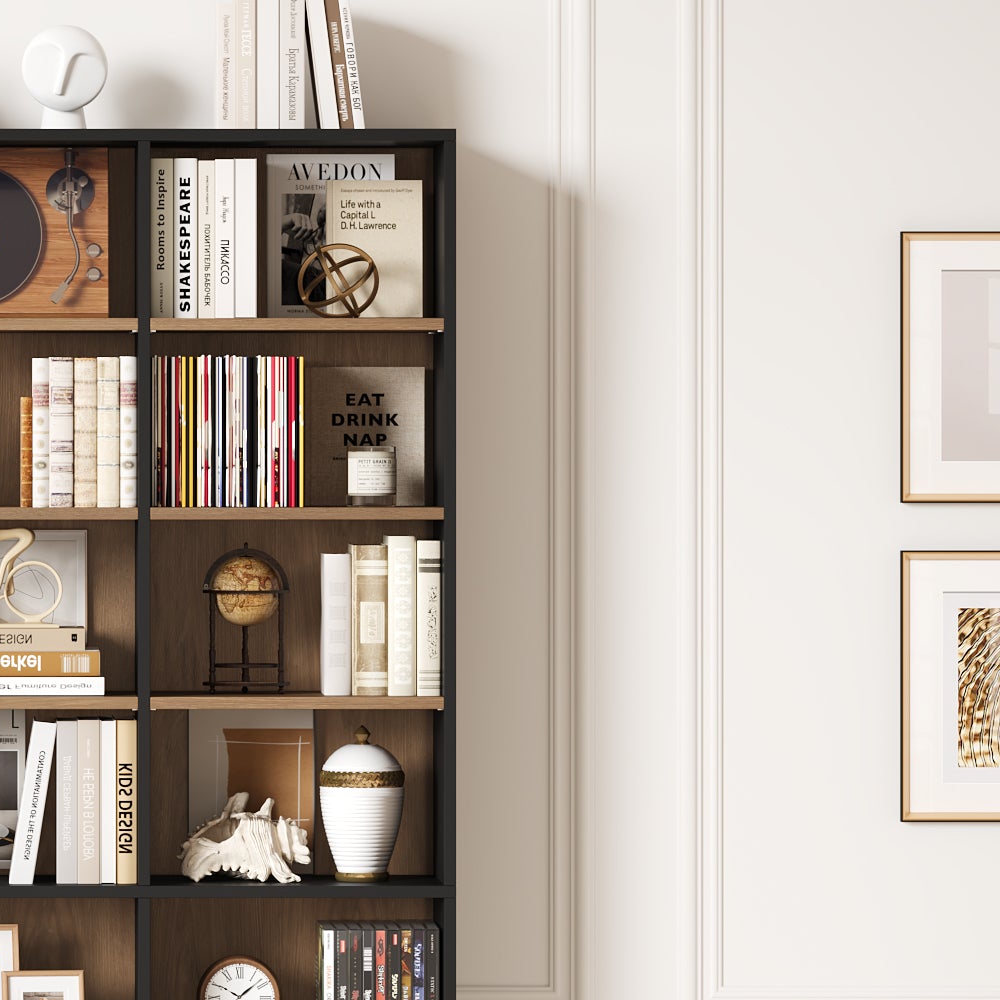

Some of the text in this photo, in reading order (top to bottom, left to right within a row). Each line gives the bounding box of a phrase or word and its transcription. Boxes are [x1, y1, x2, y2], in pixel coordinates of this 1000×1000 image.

[285, 48, 300, 121] Братья Карамазовы
[346, 42, 362, 111] ГОВОРИ КАК БОГ
[288, 163, 385, 181] AVEDON
[340, 200, 356, 209] Life
[358, 200, 375, 209] with
[156, 169, 167, 271] Rooms to Inspire
[340, 211, 376, 220] Capital L
[341, 221, 397, 230] D. H. Lawrence
[179, 177, 191, 312] SHAKESPEARE
[220, 239, 230, 285] ПИКАССО
[345, 393, 385, 407] EAT
[331, 413, 399, 427] DRINK
[343, 433, 388, 447] NAP
